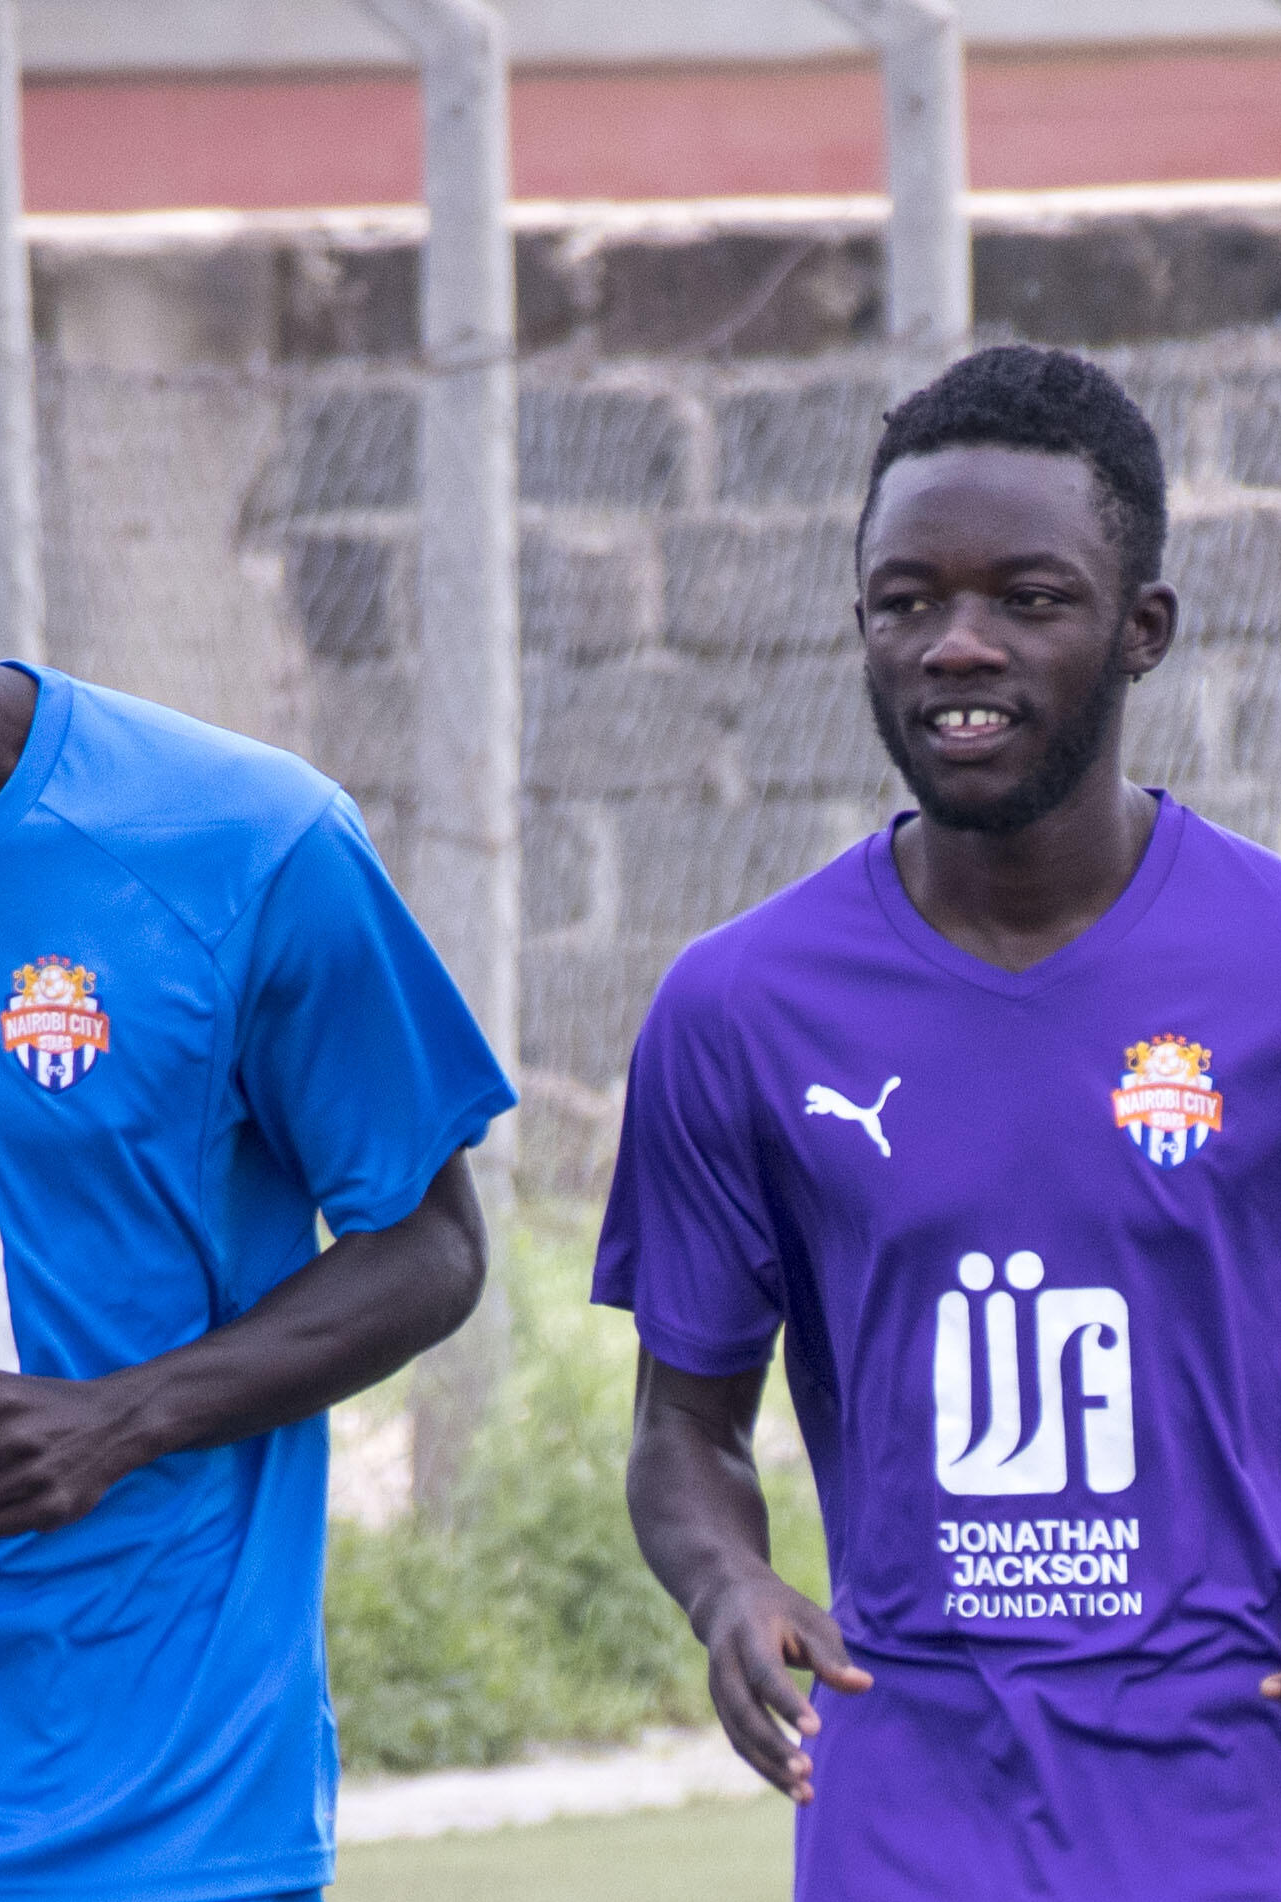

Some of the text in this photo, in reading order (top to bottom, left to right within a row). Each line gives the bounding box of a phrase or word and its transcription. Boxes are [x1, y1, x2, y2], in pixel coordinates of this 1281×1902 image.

[5, 1011, 104, 1040] NAIROBI CITY
[1117, 1087, 1218, 1118] NAIROBI CITY
[938, 1518, 1139, 1553] JONATHAN
[953, 1553, 1129, 1587] JACKSON
[944, 1591, 1143, 1619] FOUNDATION
